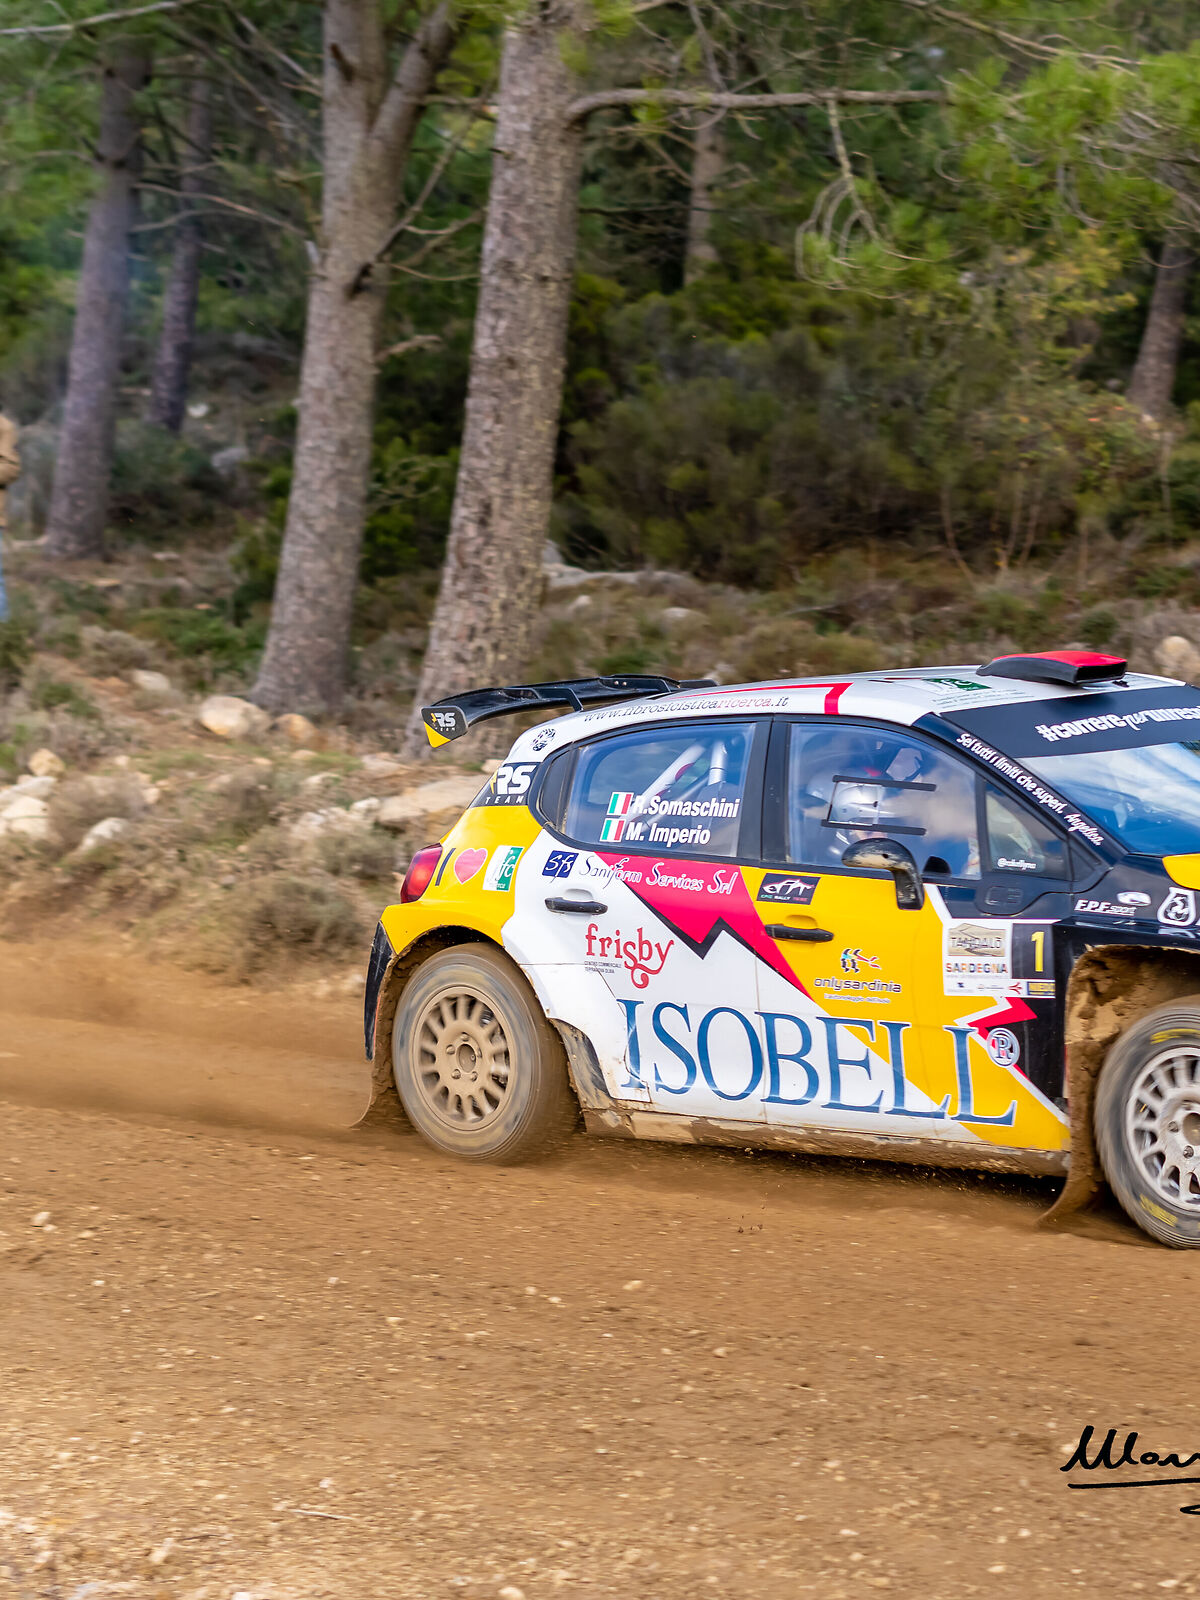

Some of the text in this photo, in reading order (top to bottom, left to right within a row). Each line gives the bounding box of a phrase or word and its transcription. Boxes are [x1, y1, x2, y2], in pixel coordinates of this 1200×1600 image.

[496, 765, 537, 795] RS
[485, 796, 525, 805] TEAM
[625, 822, 711, 847] M. Imperio
[579, 855, 738, 895] Saniform Services Srl
[585, 923, 674, 989] frisby
[1031, 931, 1045, 972] 1
[946, 963, 1008, 974] SARDEGNA
[813, 976, 902, 993] onlysardinia
[616, 999, 1017, 1126] ISOBELL
